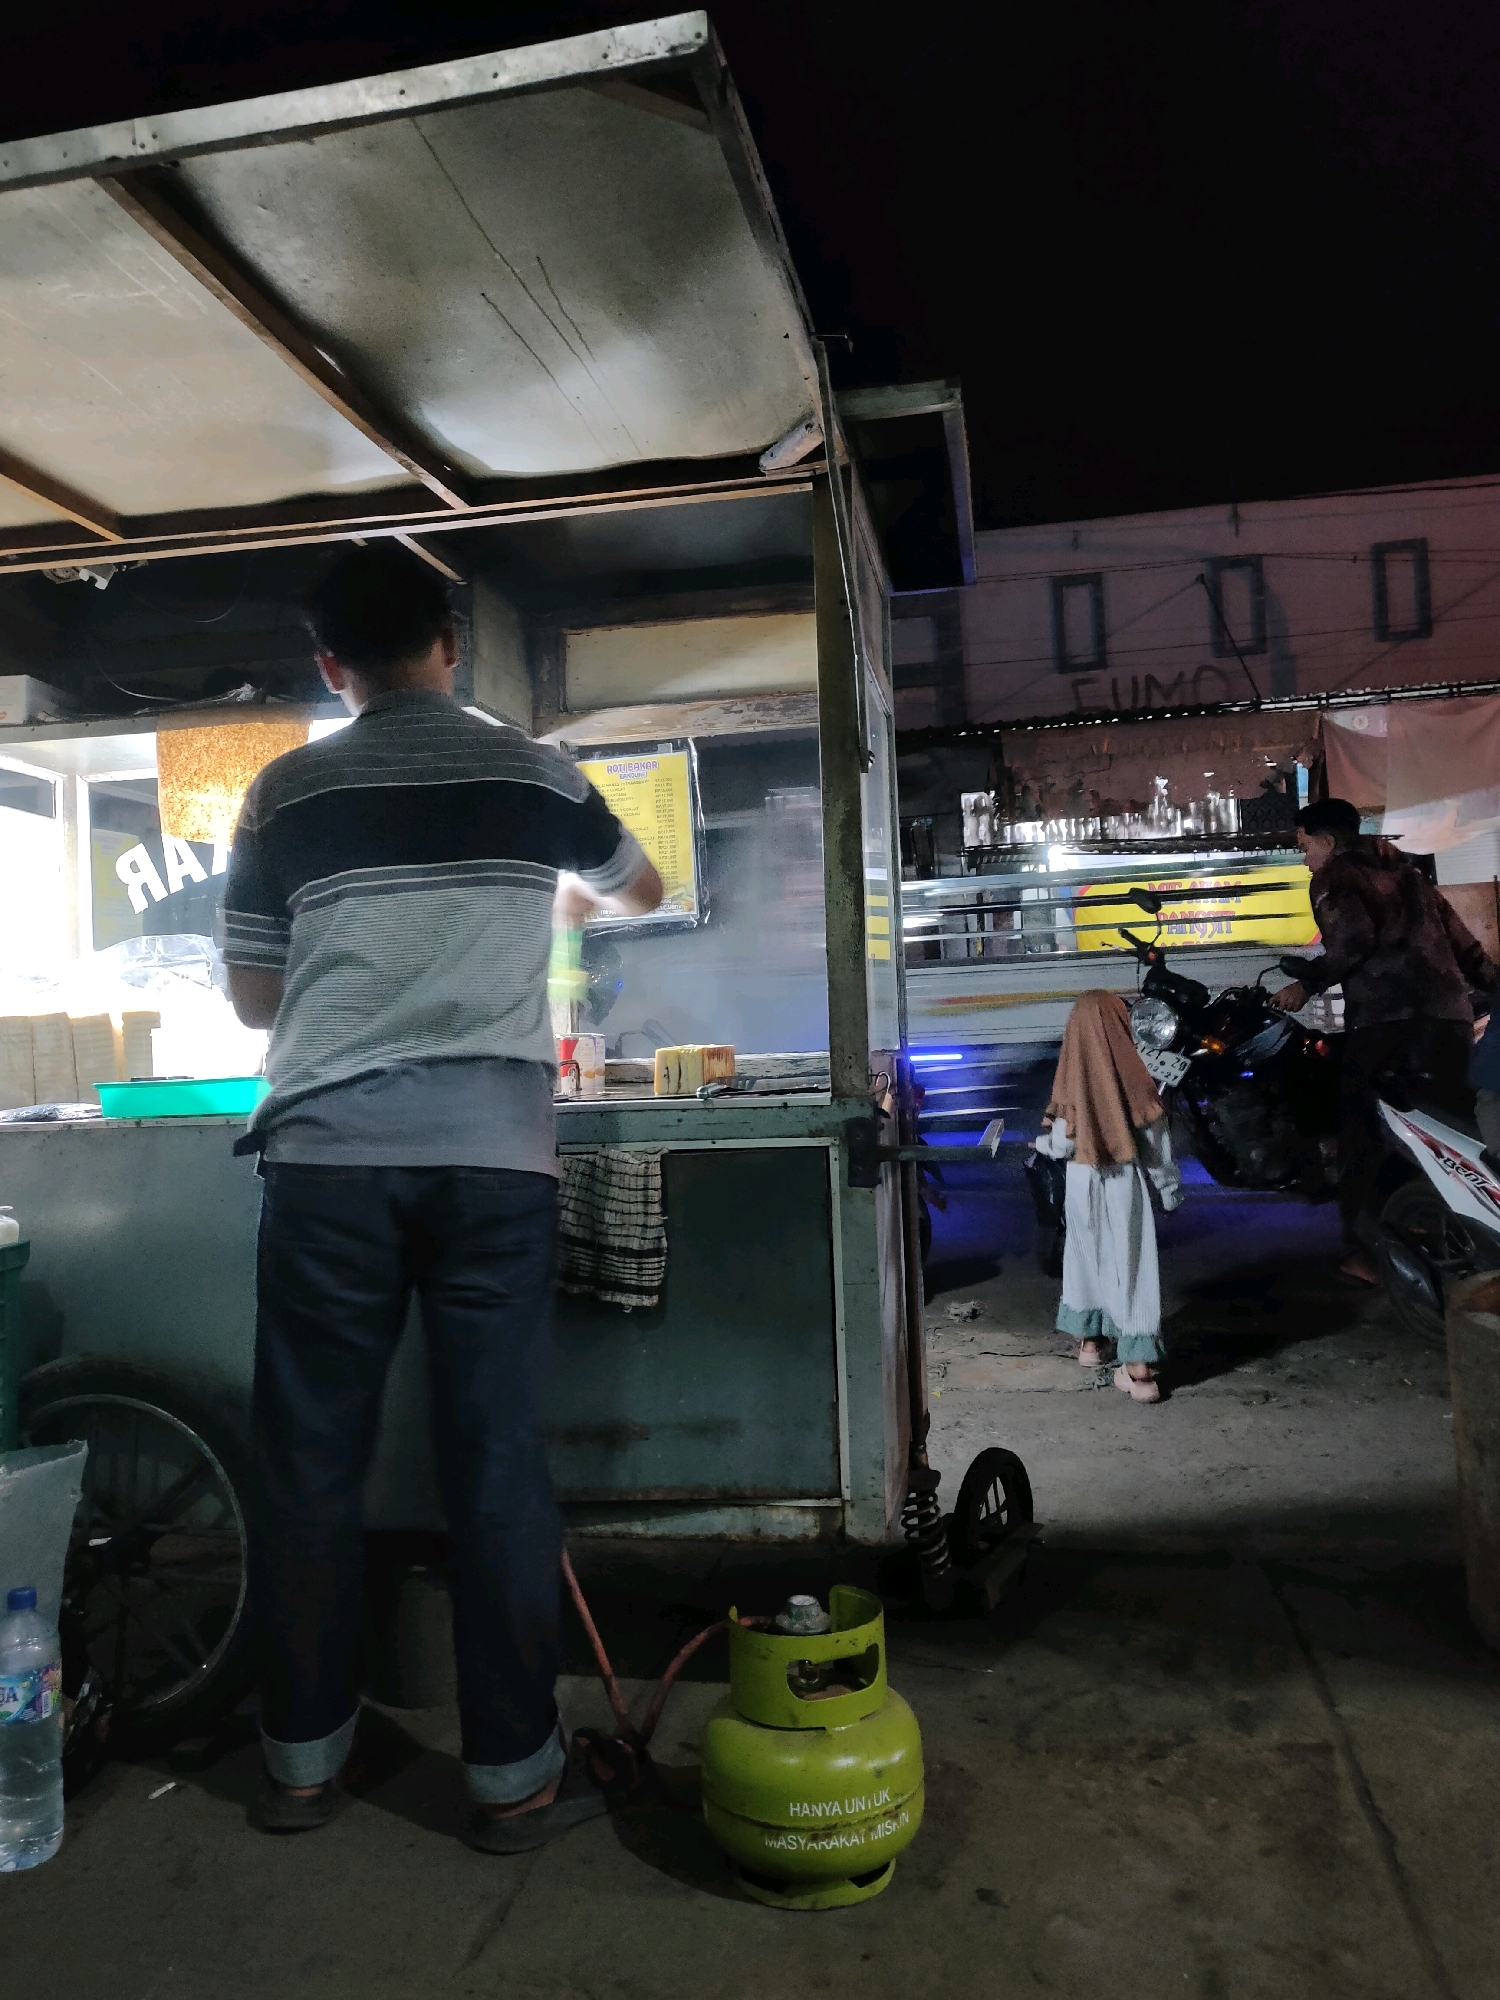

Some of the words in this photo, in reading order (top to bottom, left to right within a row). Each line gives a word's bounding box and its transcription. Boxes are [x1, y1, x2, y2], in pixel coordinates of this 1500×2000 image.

[607, 764, 626, 773] ROTI
[628, 761, 658, 771] BAKAR
[789, 1801, 842, 1817] HANYA
